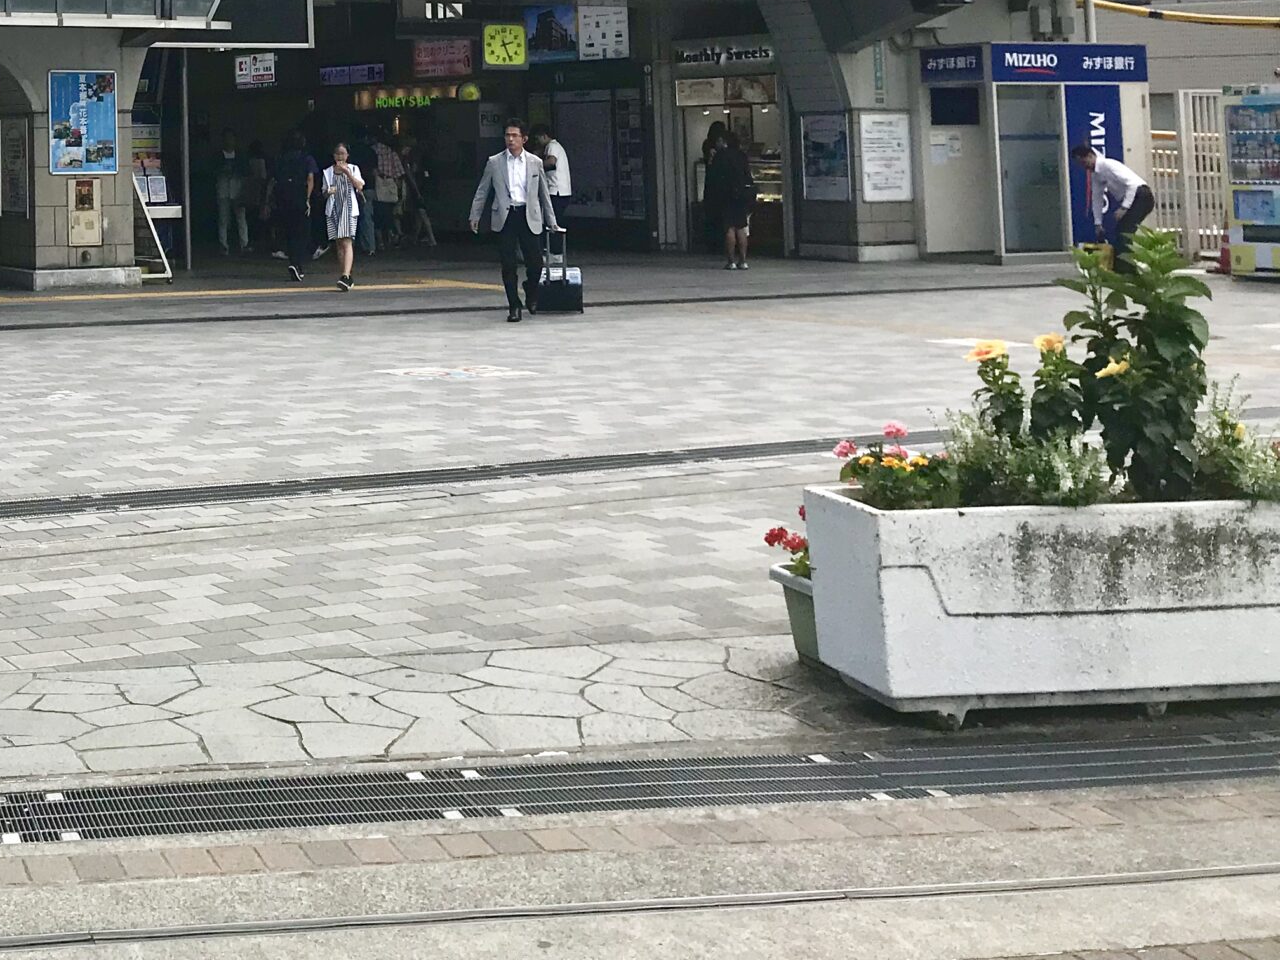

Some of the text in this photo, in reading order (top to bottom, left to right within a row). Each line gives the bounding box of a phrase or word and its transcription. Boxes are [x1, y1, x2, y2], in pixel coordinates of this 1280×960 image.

[676, 46, 770, 65] Monthly Sweets
[1005, 52, 1058, 67] MIZUHO
[1082, 56, 1135, 70] みずほ銀行
[927, 56, 977, 71] みずほ銀行
[375, 96, 415, 108] HONEY'S
